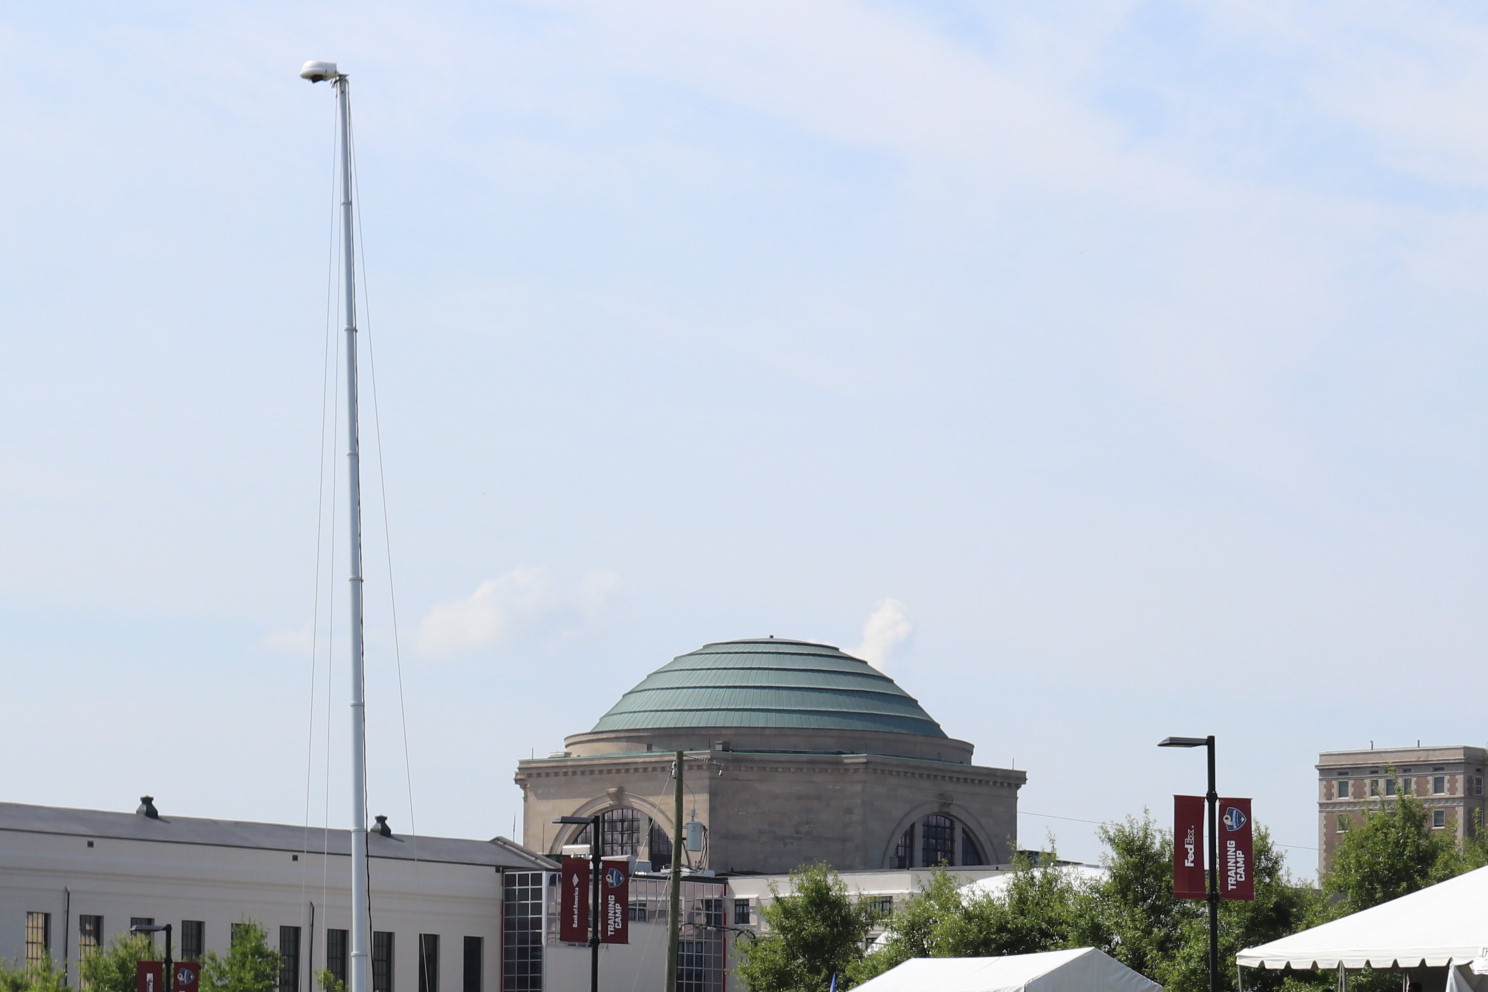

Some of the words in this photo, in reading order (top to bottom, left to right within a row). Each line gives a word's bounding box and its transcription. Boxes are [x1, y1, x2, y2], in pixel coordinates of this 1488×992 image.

[1184, 829, 1195, 867] FedEx
[1227, 840, 1237, 891] TRAINING
[1236, 850, 1245, 881] CAMP
[607, 895, 615, 936] TRAINING
